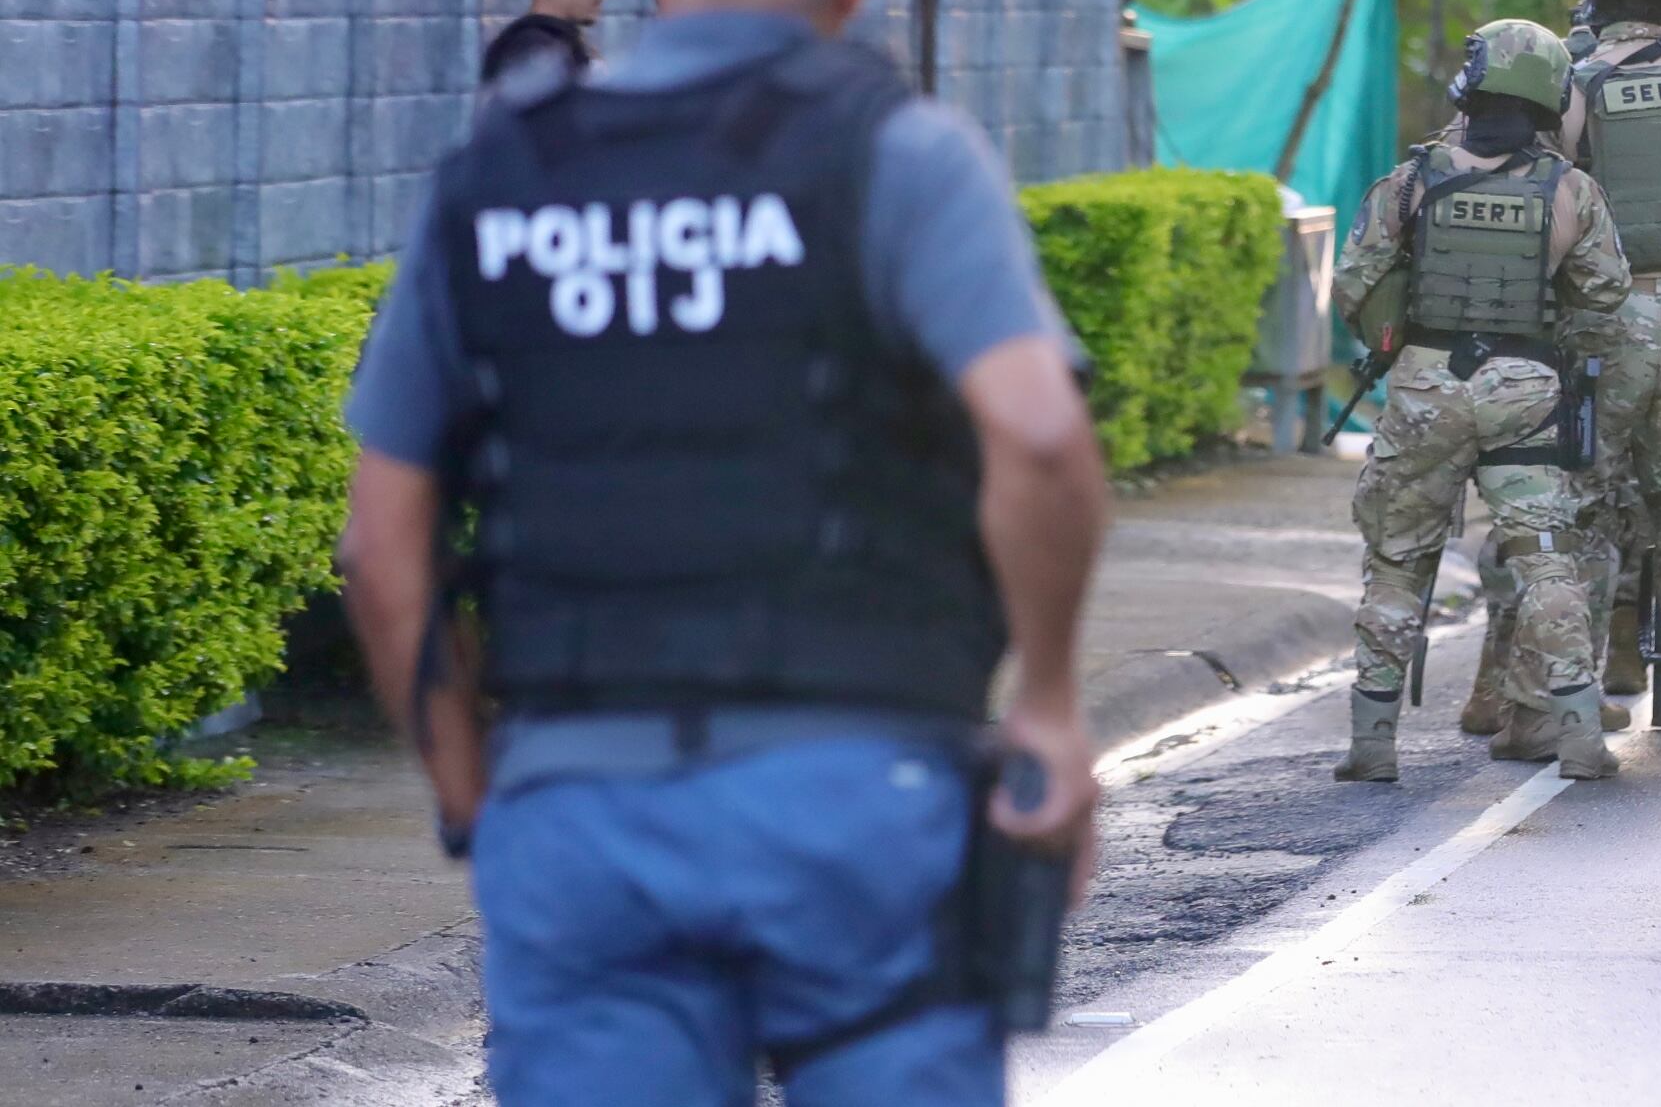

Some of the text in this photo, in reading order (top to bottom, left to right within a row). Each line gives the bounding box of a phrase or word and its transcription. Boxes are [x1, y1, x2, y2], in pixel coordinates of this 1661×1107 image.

[475, 193, 805, 281] POLICIA
[1453, 200, 1525, 223] SERT
[550, 265, 725, 338] OIJ
